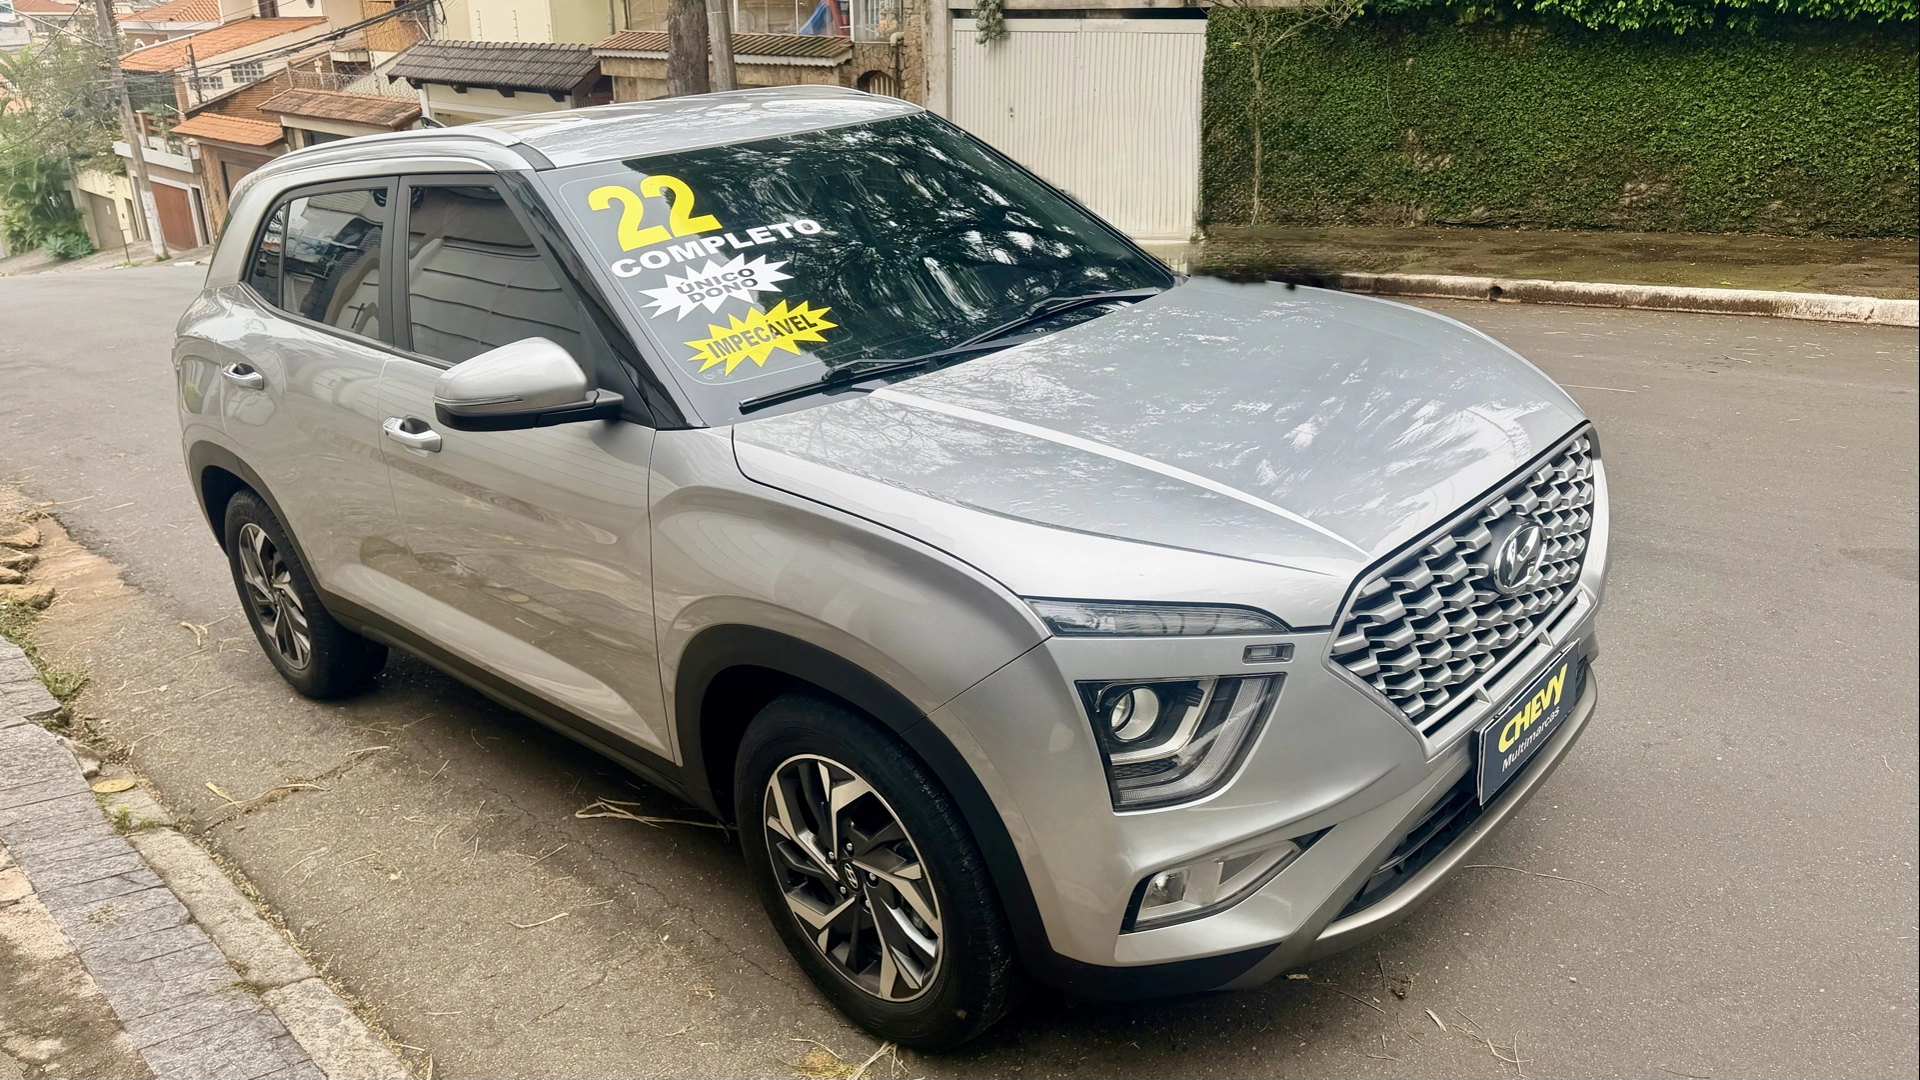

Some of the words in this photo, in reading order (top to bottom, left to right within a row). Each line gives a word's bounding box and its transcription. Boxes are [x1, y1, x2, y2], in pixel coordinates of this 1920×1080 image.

[588, 175, 723, 252] 22
[611, 219, 821, 278] COMPLETO
[676, 268, 755, 295] ÚNICO
[687, 278, 759, 303] DONO
[707, 313, 817, 359] IMPECÁVEL
[1498, 663, 1568, 753] CHEVY
[1501, 706, 1560, 772] Multimarcas
